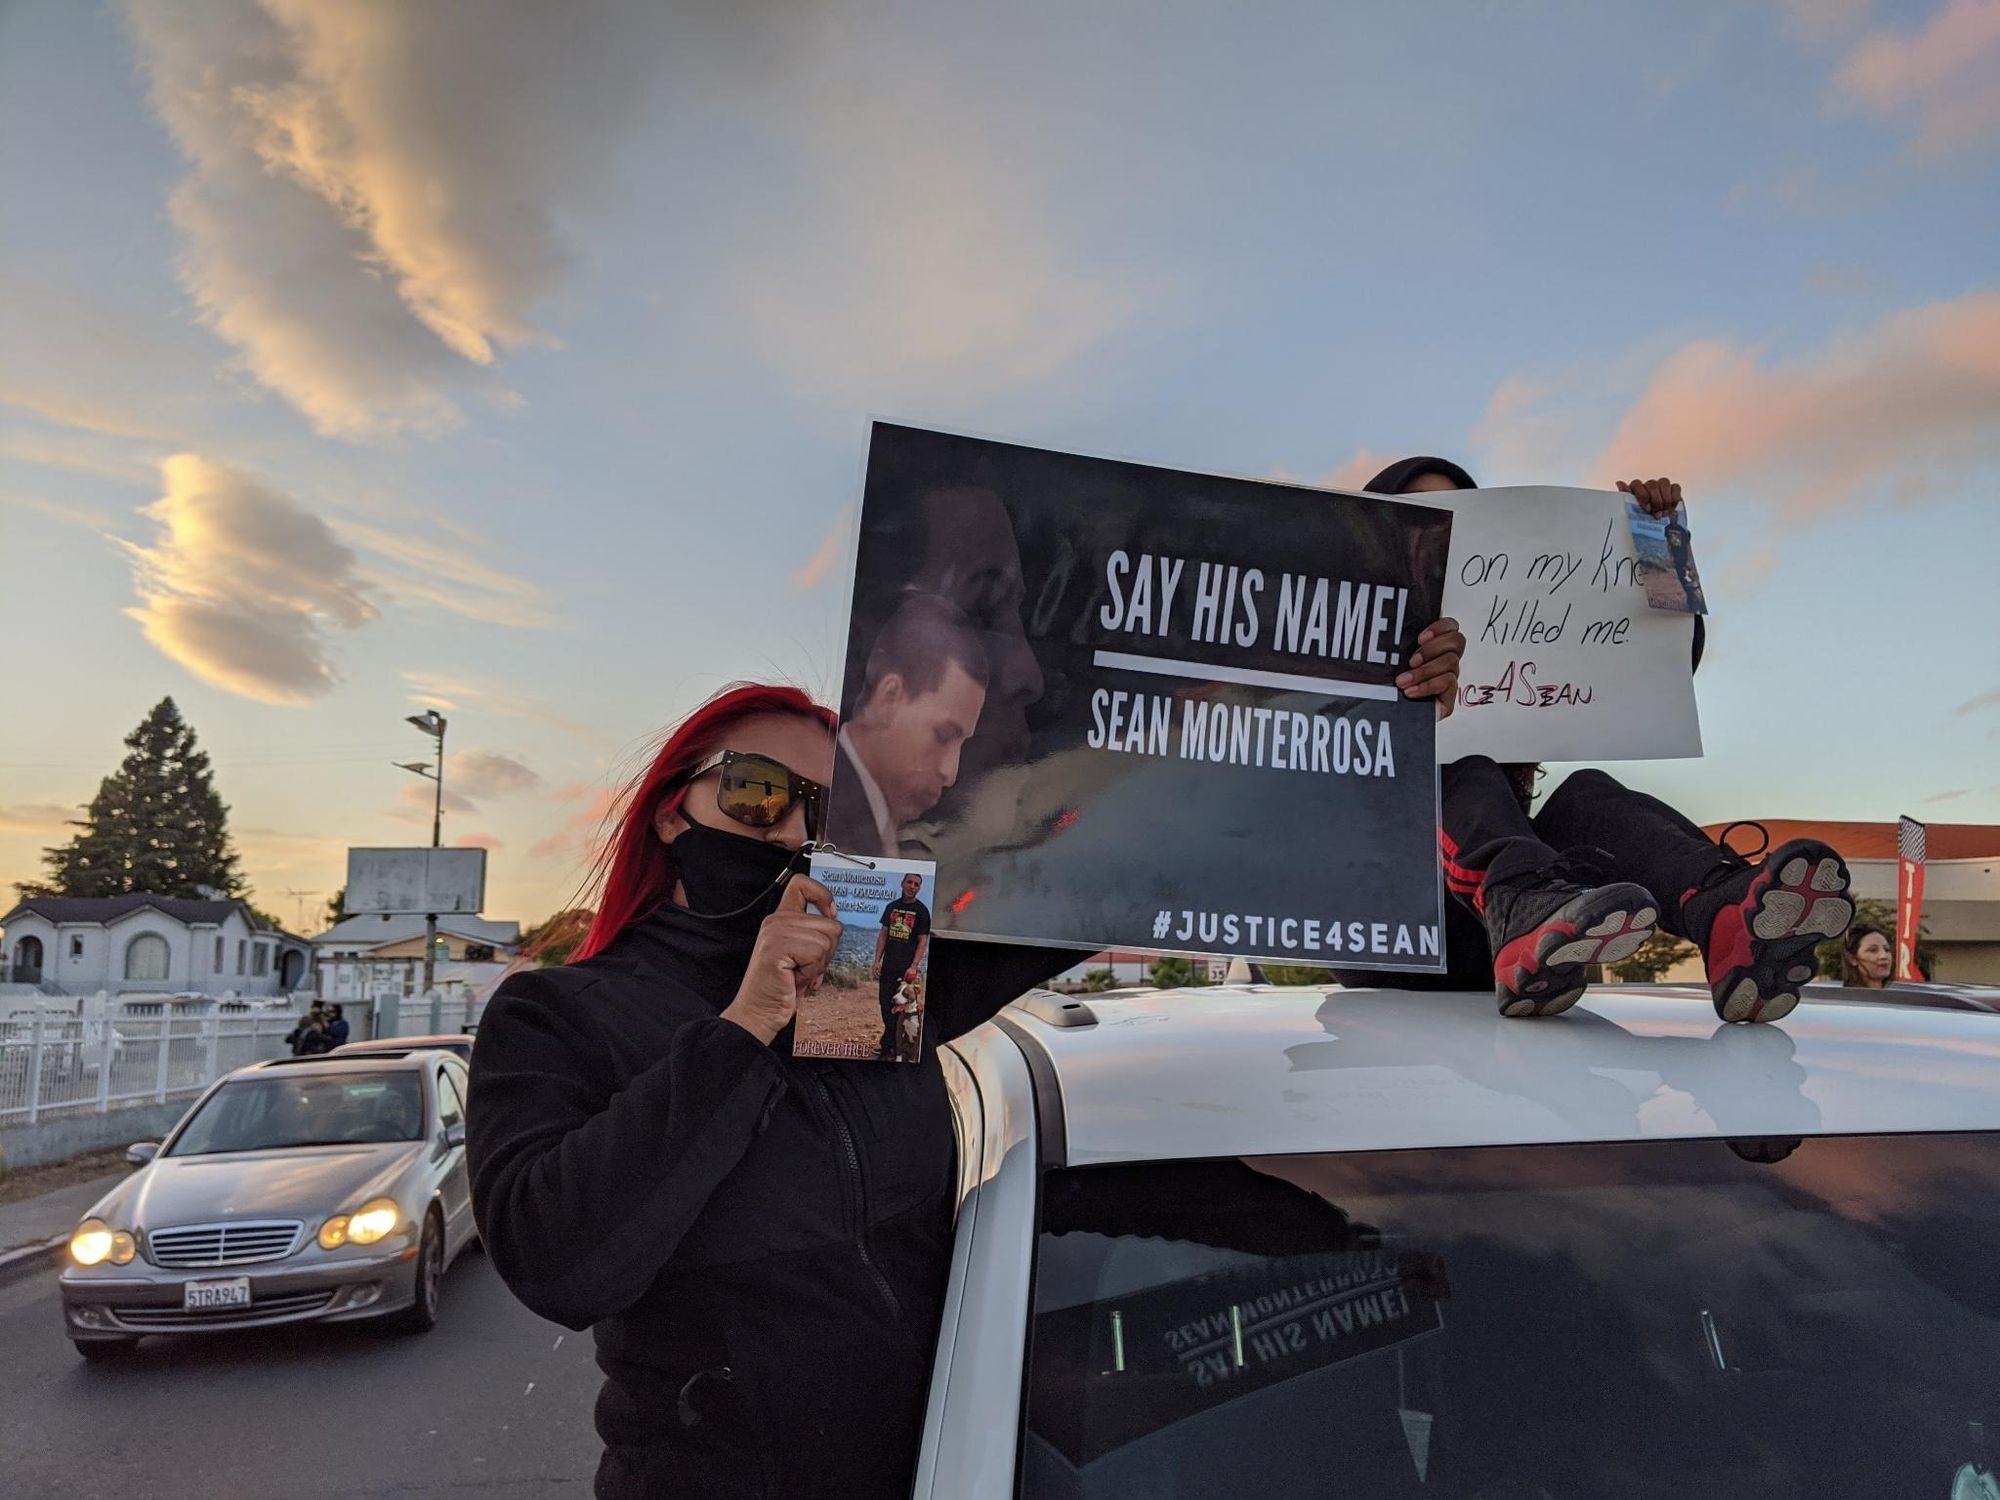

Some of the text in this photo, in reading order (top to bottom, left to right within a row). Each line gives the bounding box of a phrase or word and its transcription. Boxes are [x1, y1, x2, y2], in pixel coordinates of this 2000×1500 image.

[1461, 517, 1648, 596] on my kne
[1100, 550, 1409, 666] SAY HIS NAME!
[1087, 688, 1396, 778] SEAN MONTERROSA
[1152, 910, 1439, 956] #JUSTICE4SEAN
[1900, 861, 1916, 979] TIR
[793, 1041, 869, 1057] FOREVER TRUE
[188, 1286, 247, 1306] 5TRA947
